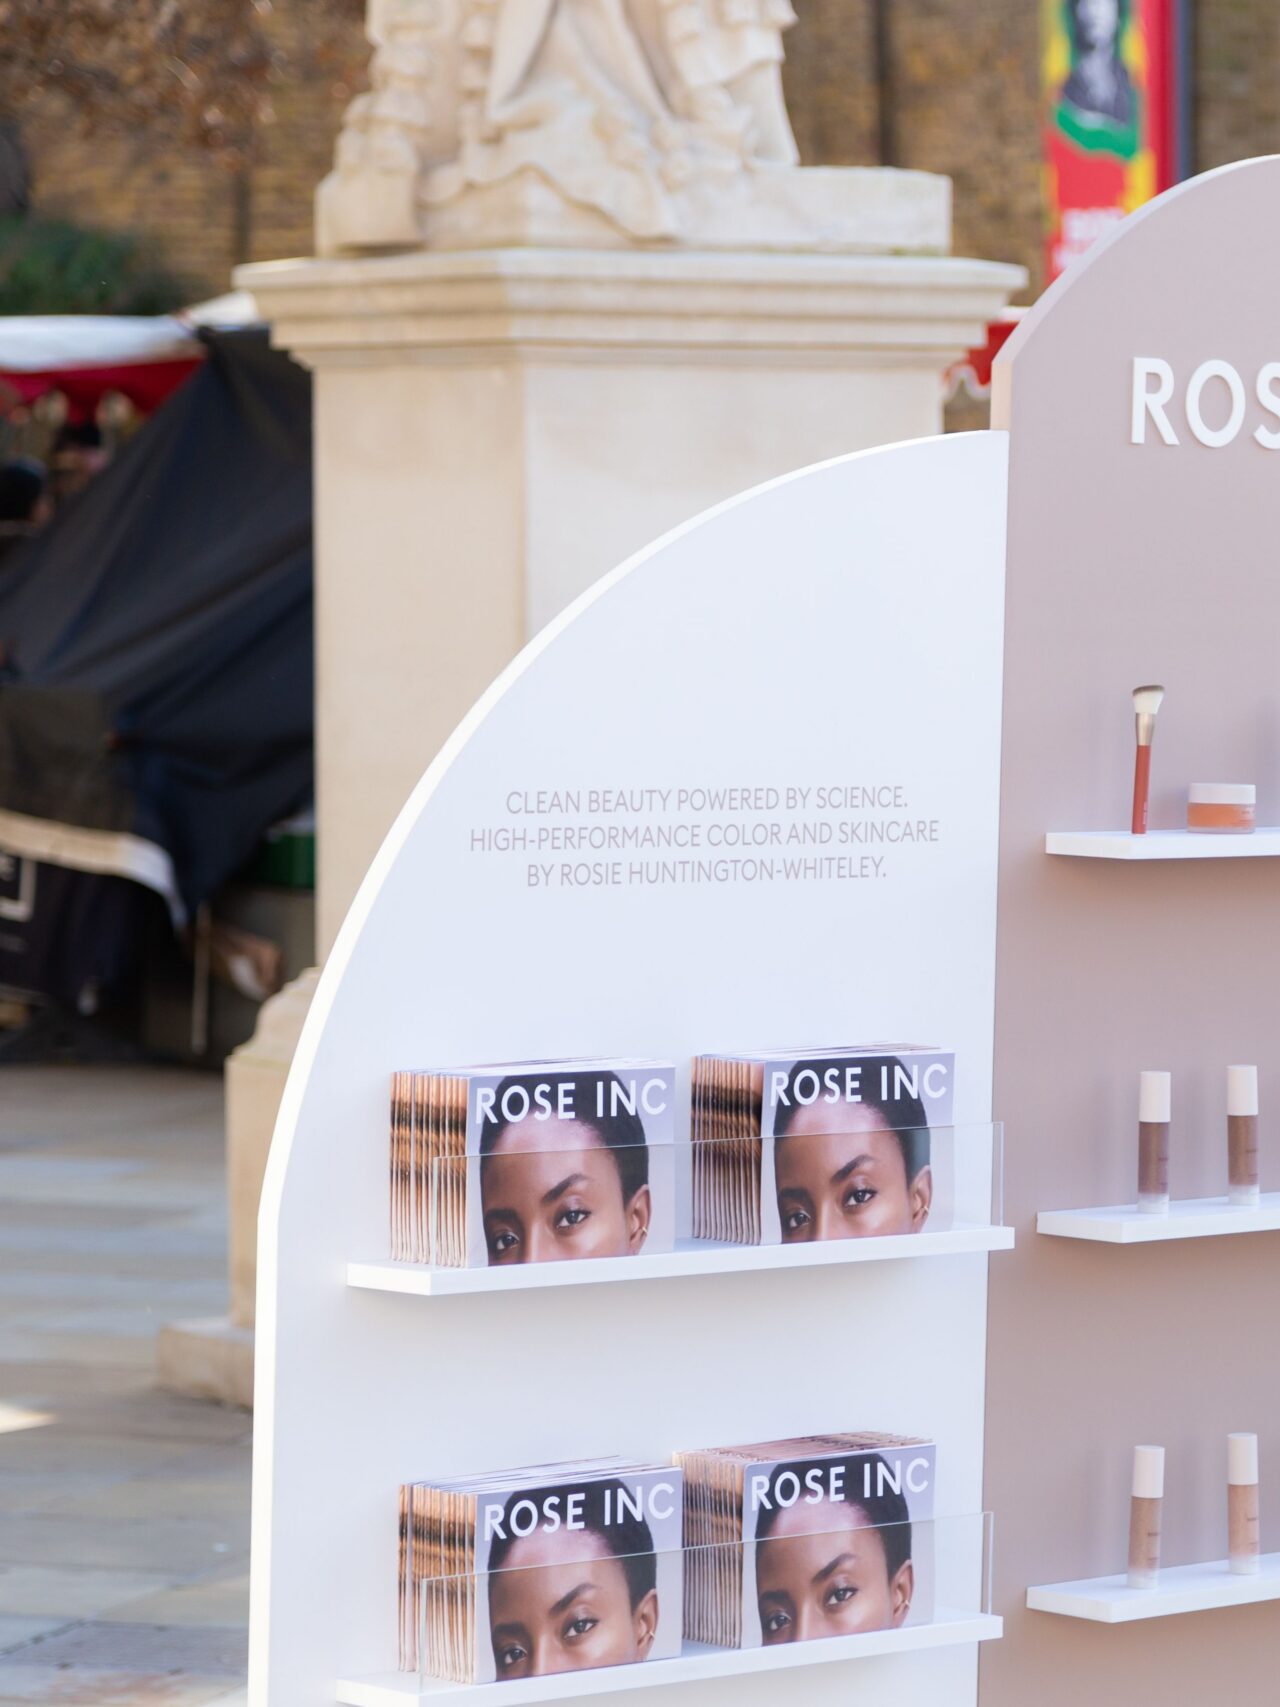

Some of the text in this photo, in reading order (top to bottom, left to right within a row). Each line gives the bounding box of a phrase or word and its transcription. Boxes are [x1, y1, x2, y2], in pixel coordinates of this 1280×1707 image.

[506, 786, 909, 815] CLEAN BEAUTY POWERED BY SCIENCE.
[470, 820, 940, 852] HIGH-PERFORMANCE COLOR AND SKINCARE
[526, 856, 887, 887] BY ROSIE HUNTINGTON-WHITELEY.
[475, 1077, 669, 1125] ROSE INC
[769, 1062, 948, 1109] ROSE INC
[750, 1457, 931, 1511] ROSE INC
[484, 1482, 677, 1541] ROSE INC
